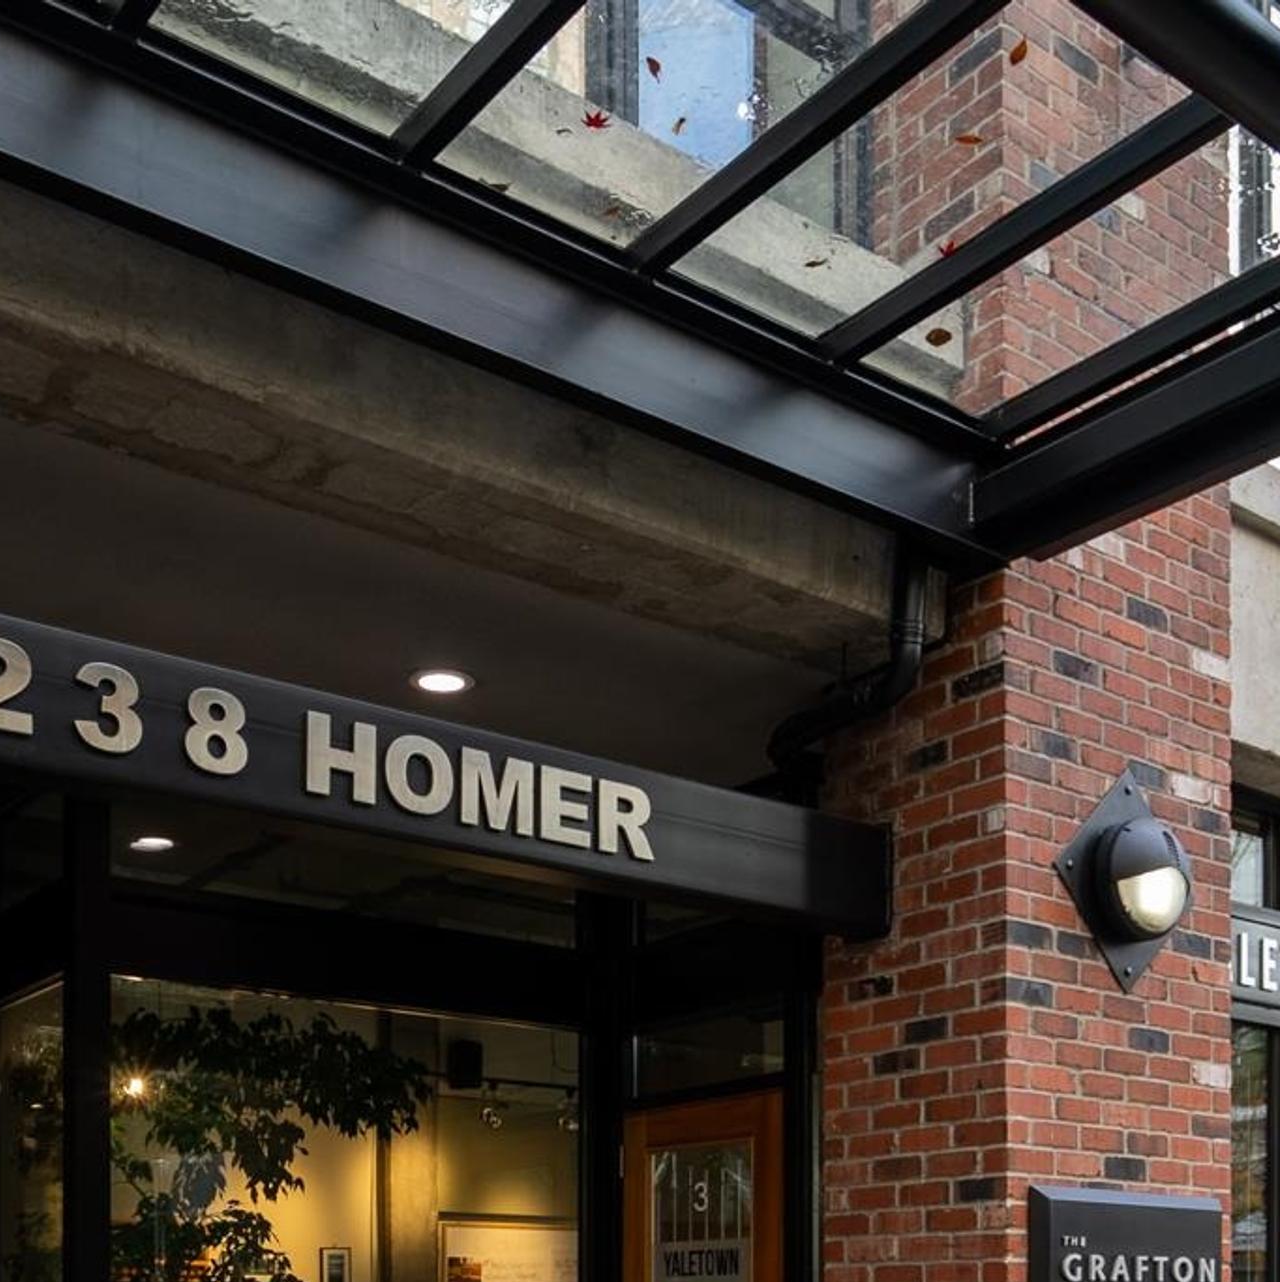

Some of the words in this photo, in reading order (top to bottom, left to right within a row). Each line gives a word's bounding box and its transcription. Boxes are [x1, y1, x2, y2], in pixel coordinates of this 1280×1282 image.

[305, 710, 656, 861] HOMER
[692, 1181, 710, 1213] 3
[1062, 1234, 1087, 1248] THE
[663, 1248, 740, 1278] YALETOWN
